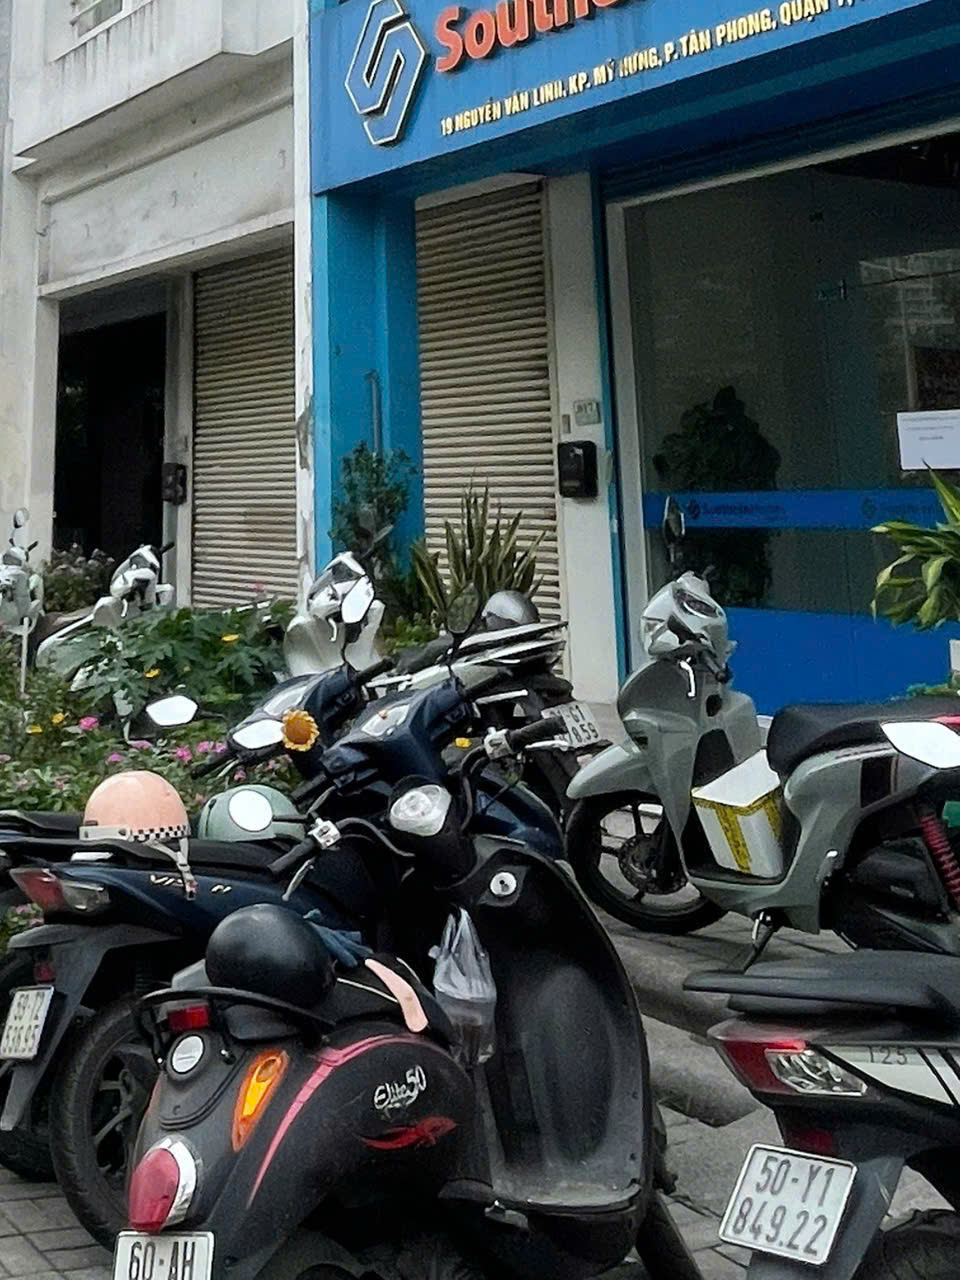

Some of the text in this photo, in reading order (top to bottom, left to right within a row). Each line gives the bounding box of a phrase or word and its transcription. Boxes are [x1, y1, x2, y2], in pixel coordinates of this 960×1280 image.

[440, 117, 454, 136] 19
[867, 1046, 910, 1066] 125
[755, 1155, 836, 1207] 50-Y1
[732, 1196, 828, 1256] 849.22
[128, 1240, 196, 1280] 60-AH
